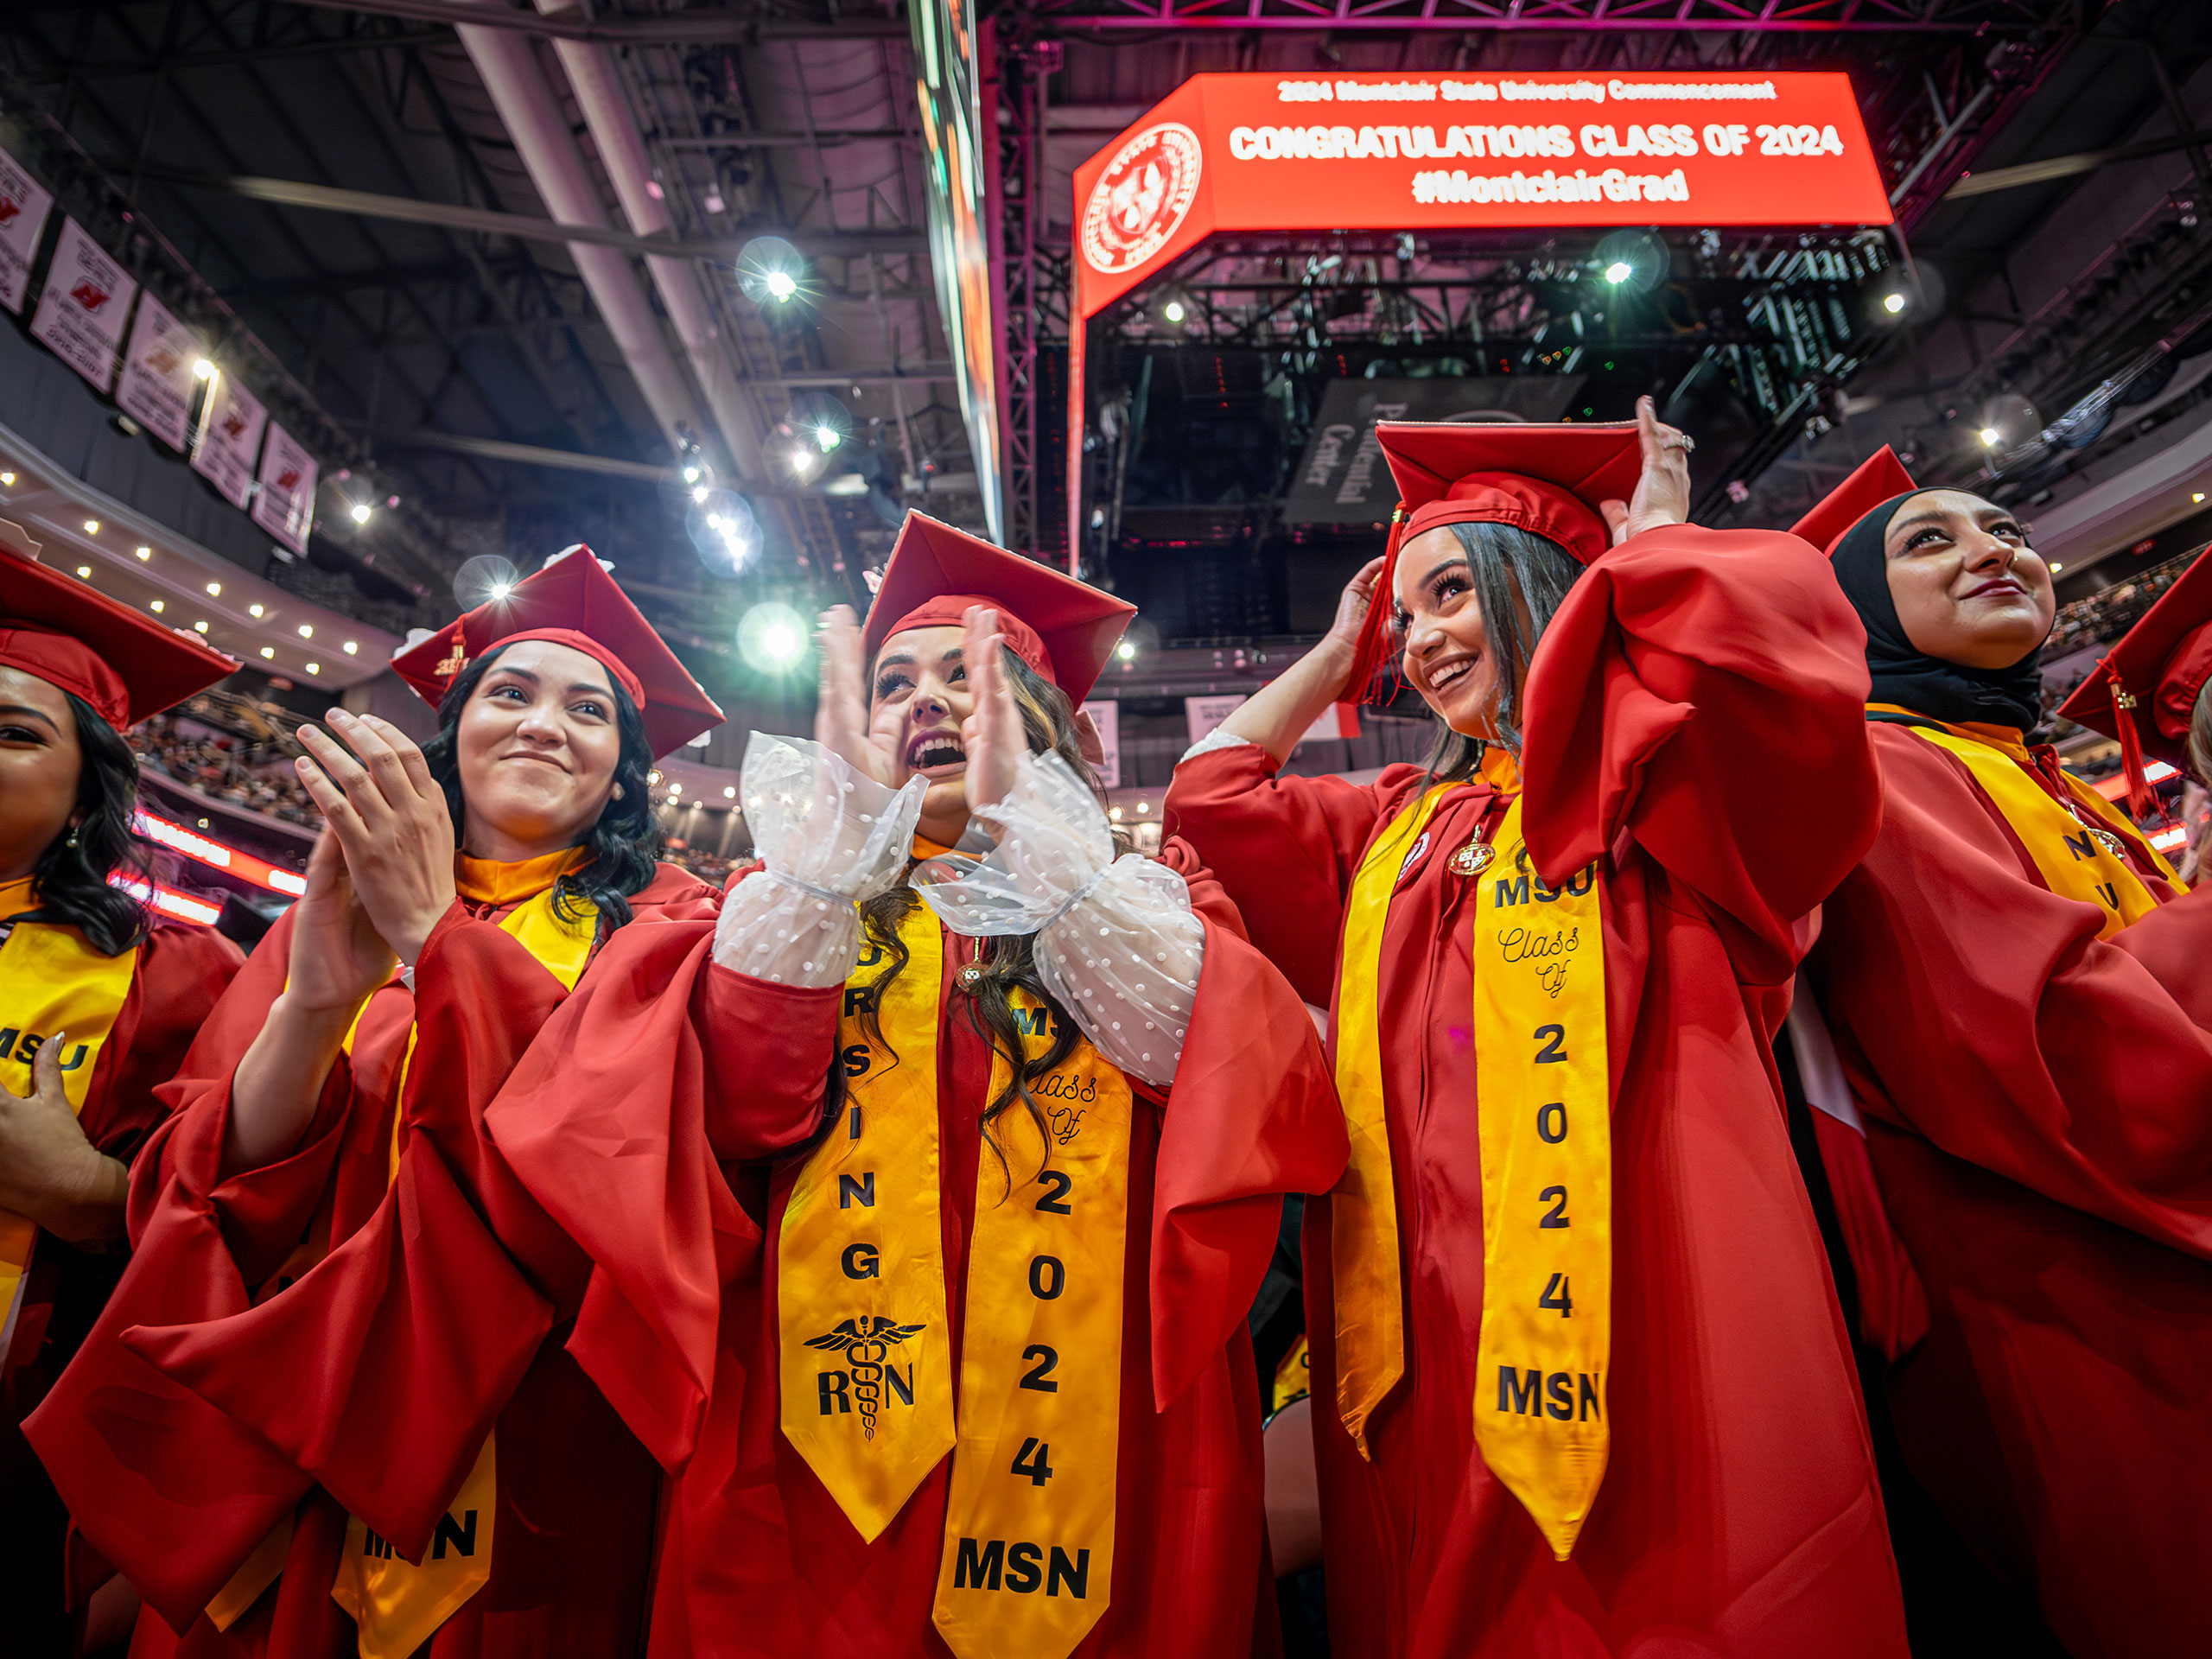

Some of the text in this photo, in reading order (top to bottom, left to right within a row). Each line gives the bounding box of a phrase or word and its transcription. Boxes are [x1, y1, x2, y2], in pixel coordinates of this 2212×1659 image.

[1278, 79, 1777, 104] 2024 Montclair State University Commencement
[1229, 124, 1845, 161] CONGRATULATIONS CLASS OF 2024
[1412, 168, 1690, 203] #MontclairGrad
[1498, 927, 1580, 963] Class
[1535, 959, 1572, 999] Of
[1030, 1073, 1096, 1103] lass
[1047, 1105, 1086, 1146] Of
[1497, 1365, 1599, 1422] MSN
[953, 1537, 1090, 1599] MSN
